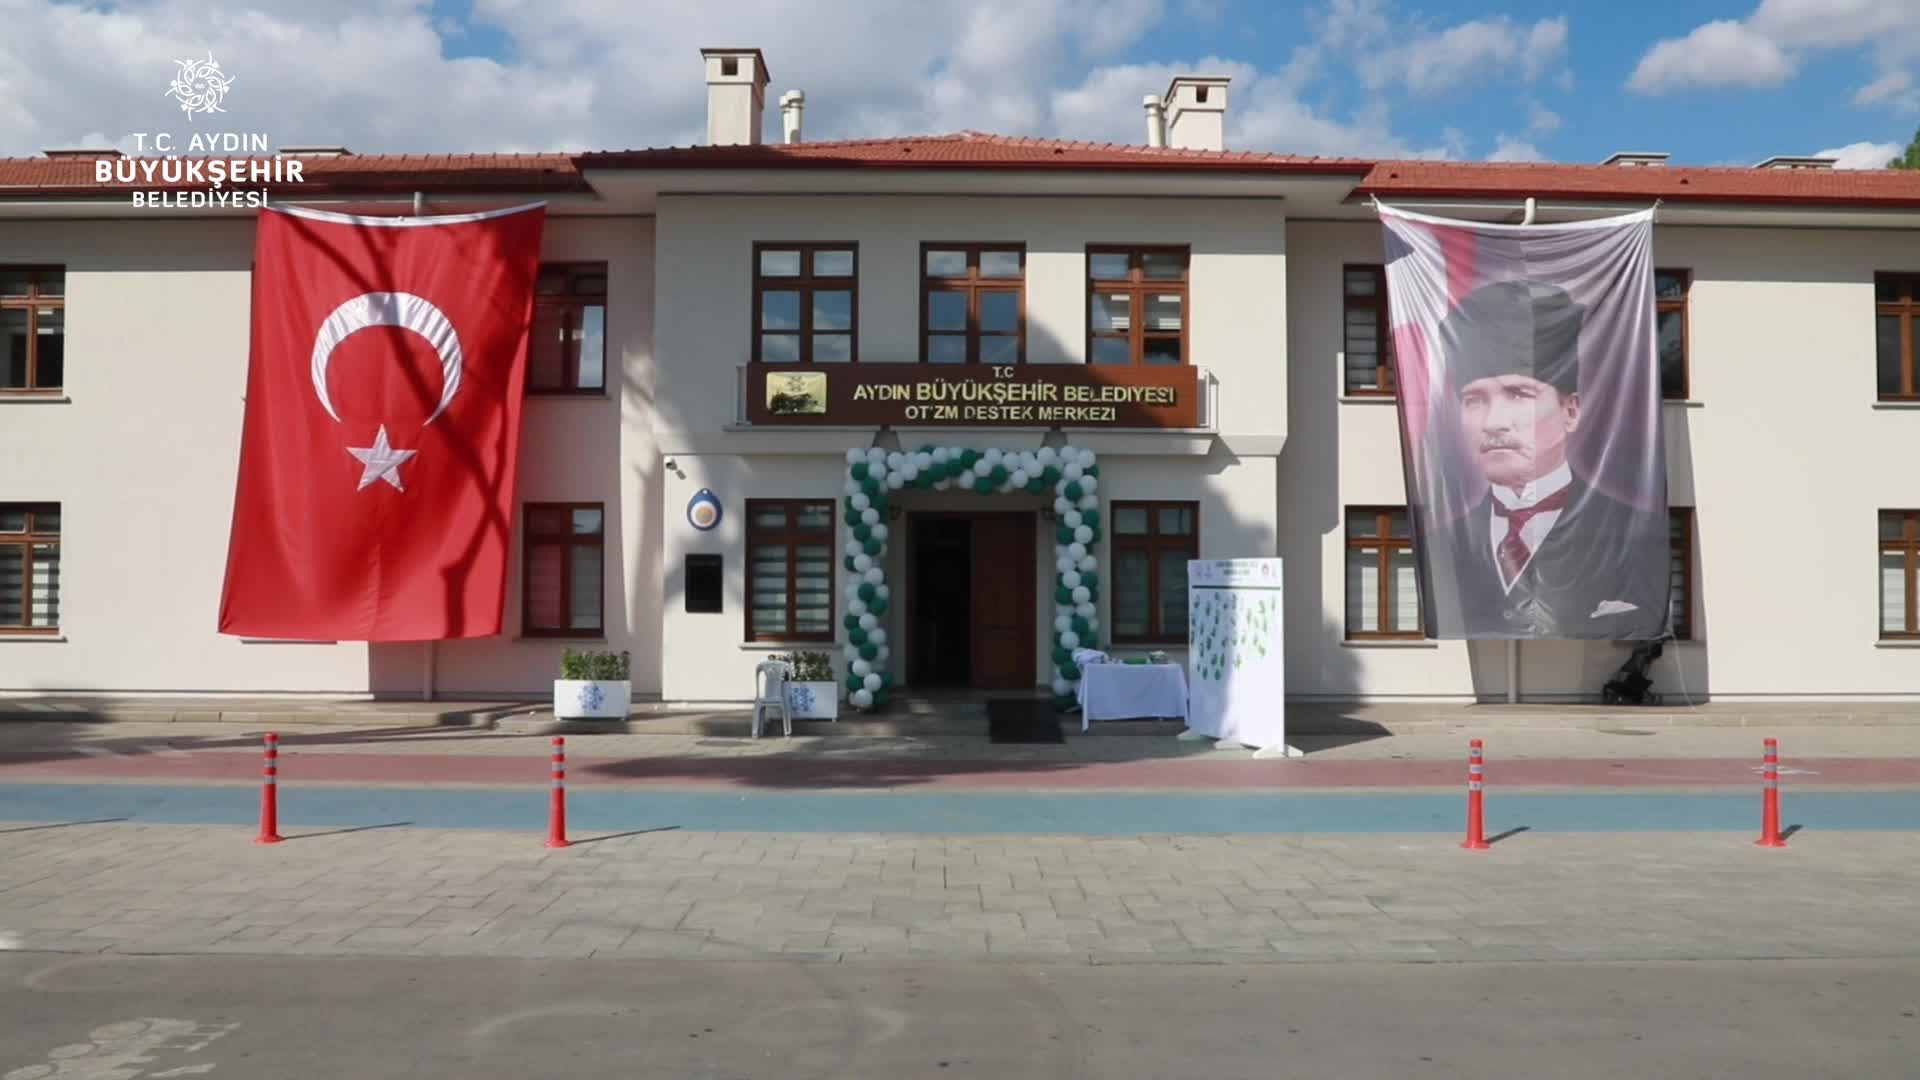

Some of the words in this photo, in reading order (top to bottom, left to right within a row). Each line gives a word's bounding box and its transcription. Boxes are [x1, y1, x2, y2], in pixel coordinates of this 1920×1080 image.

[853, 383, 911, 401] AYDIN
[916, 378, 1058, 405] BÜYÜKŞEHİR
[904, 405, 959, 420] OTZM
[964, 406, 1034, 420] DESTEK
